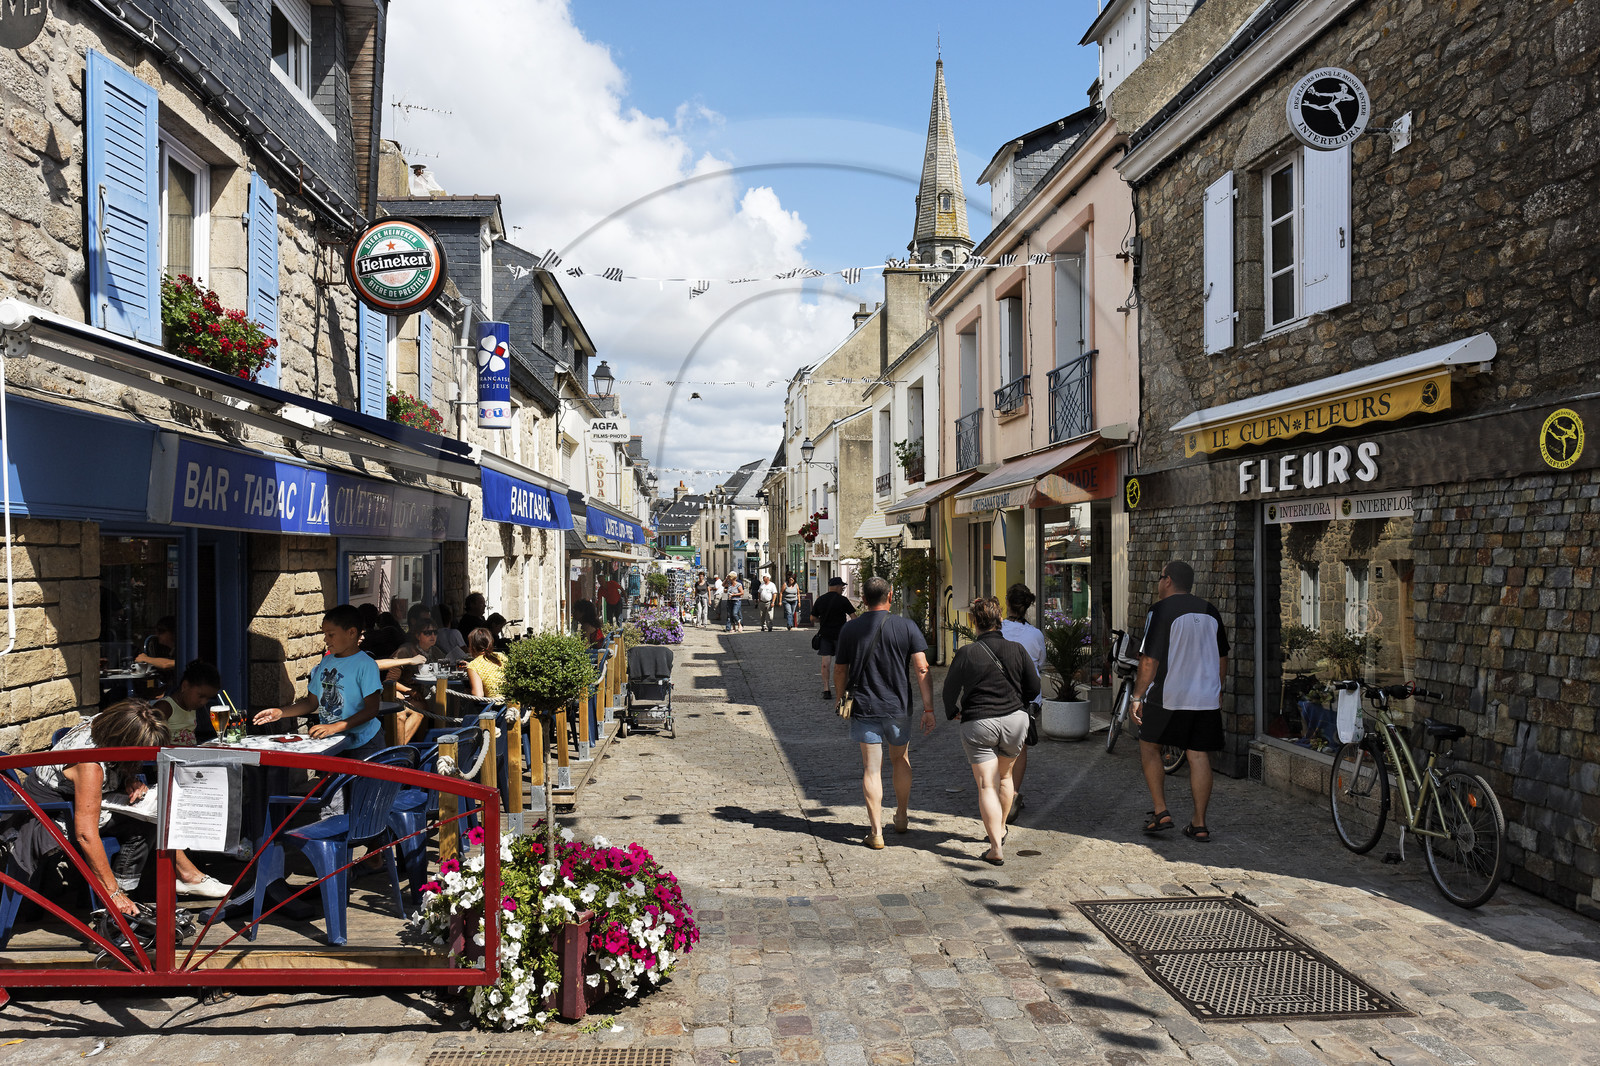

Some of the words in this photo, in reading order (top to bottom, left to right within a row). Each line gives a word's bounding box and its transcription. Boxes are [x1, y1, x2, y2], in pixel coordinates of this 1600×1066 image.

[1296, 75, 1315, 98] FLEURS
[1332, 70, 1342, 78] LE
[1341, 73, 1361, 93] MONDE
[1358, 91, 1367, 116] ENTIER
[1298, 121, 1361, 145] INTERFLORA
[364, 232, 382, 250] BIERE
[383, 229, 418, 244] HEINEKEN
[361, 254, 428, 273] Heineken
[368, 279, 387, 297] BIERE
[389, 290, 398, 298] DE
[399, 273, 427, 297] PRESTIGE
[479, 408, 511, 419] LOTO
[591, 422, 618, 430] AGFA
[1212, 428, 1230, 449] LE
[1239, 414, 1291, 443] GUEN
[1303, 392, 1392, 431] FLEURS
[1239, 441, 1381, 495] FLEURS
[1541, 443, 1574, 468] INTERFLORA
[183, 461, 230, 512] BAR
[244, 473, 298, 520] TABAC
[306, 482, 330, 526] LA
[334, 484, 390, 527] CIVETTE
[1040, 466, 1098, 497] ESKAPADE
[510, 485, 529, 518] BAR
[528, 491, 552, 522] TABAC
[972, 495, 996, 512] ARTISANAT
[996, 492, 1011, 507] D'ART
[1279, 502, 1332, 519] INTERFLORA
[1356, 495, 1414, 514] INTERFLOR
